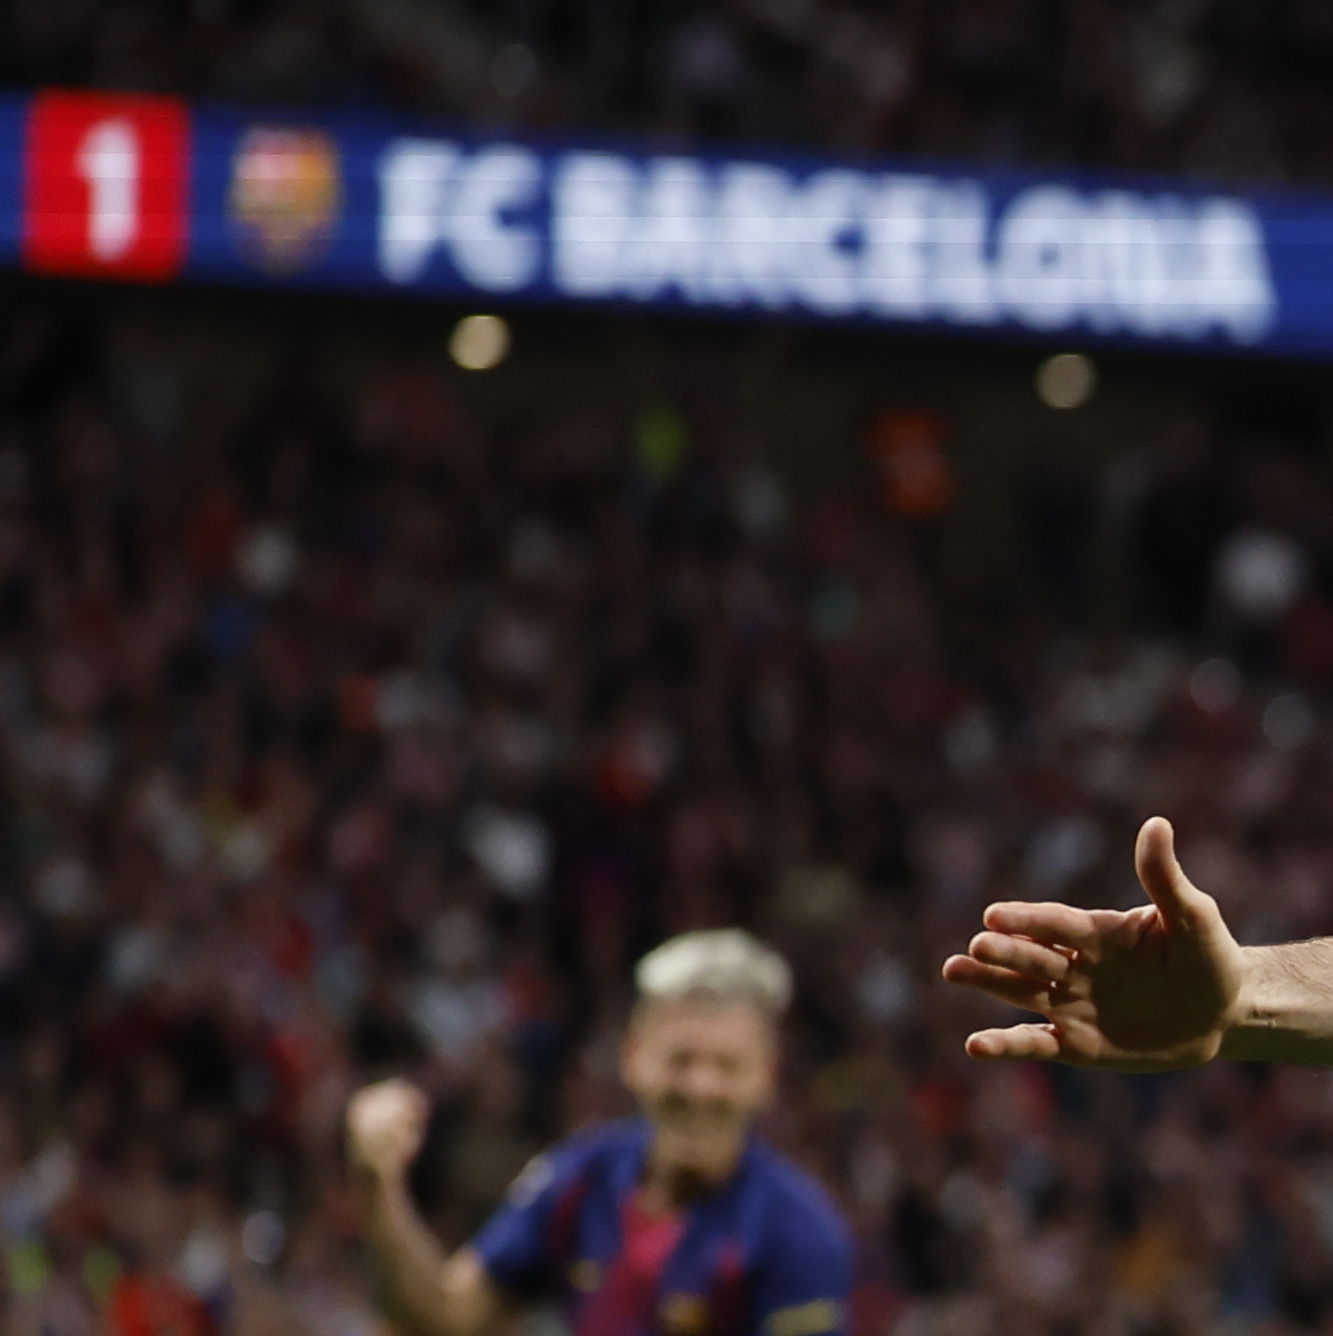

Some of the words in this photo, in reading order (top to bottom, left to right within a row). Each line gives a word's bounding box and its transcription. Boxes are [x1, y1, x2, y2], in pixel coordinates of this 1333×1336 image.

[80, 116, 141, 262] 1
[376, 136, 545, 292] FC
[551, 150, 1277, 344] BARCELONA
